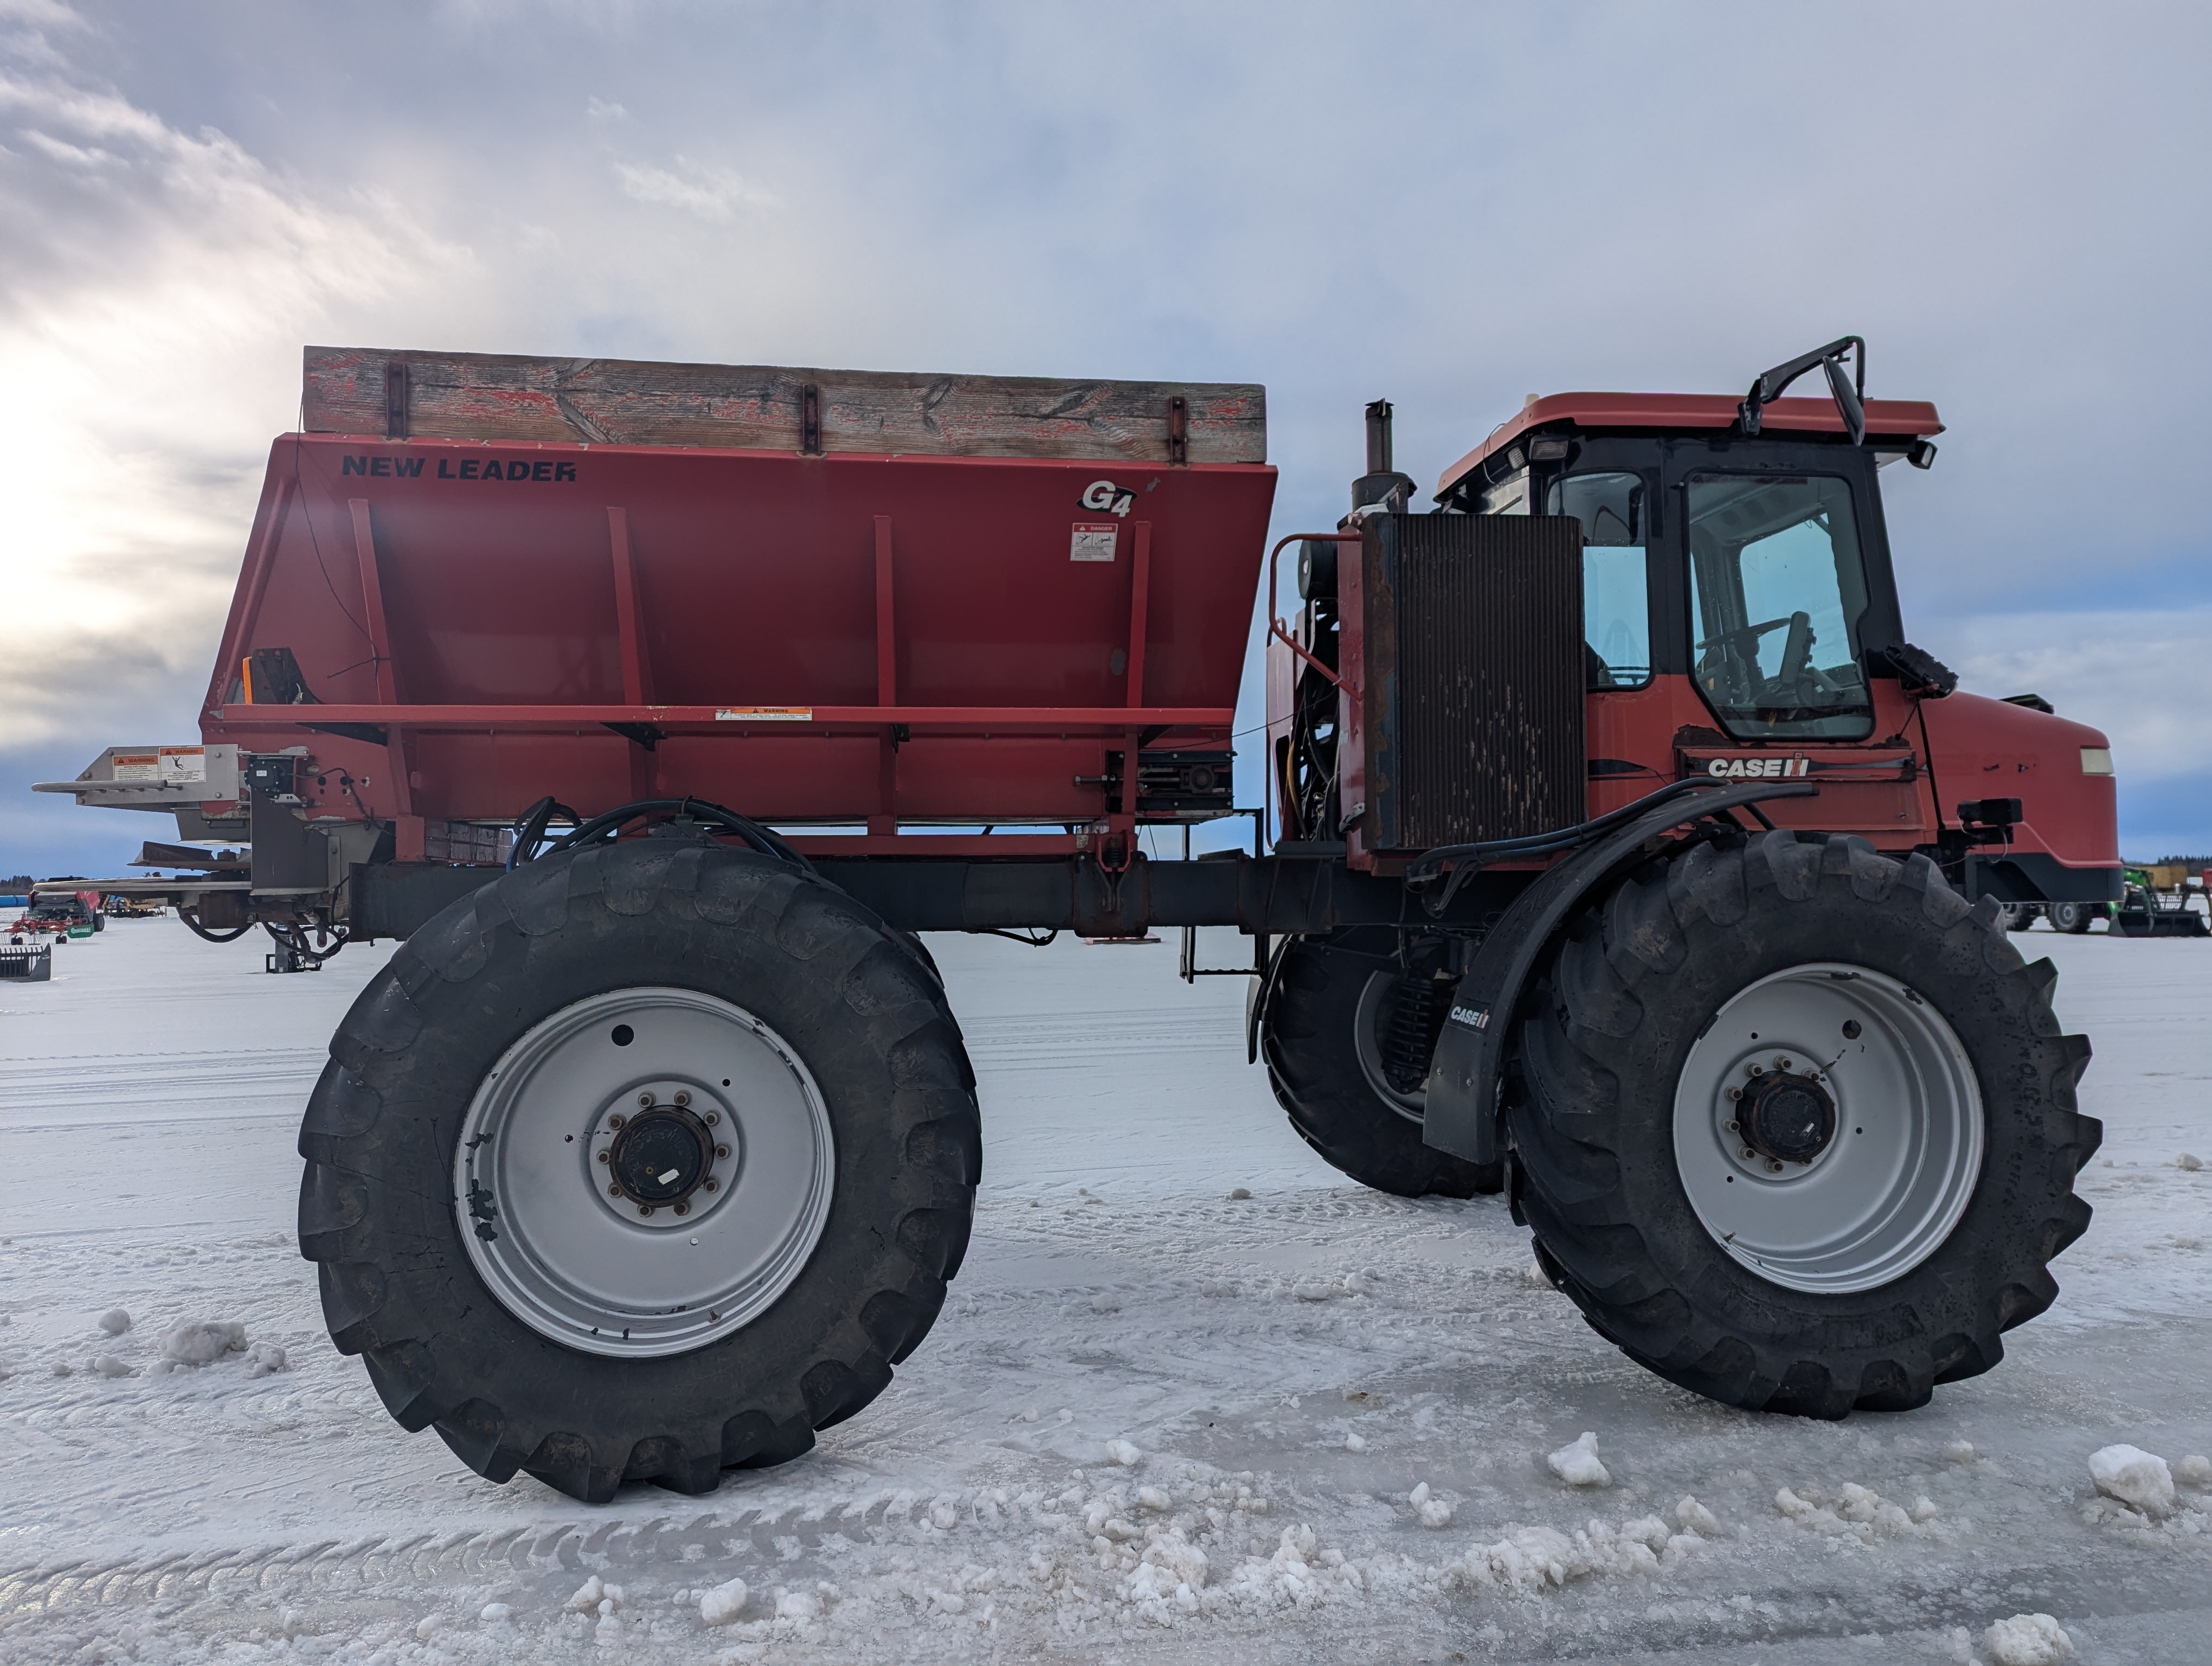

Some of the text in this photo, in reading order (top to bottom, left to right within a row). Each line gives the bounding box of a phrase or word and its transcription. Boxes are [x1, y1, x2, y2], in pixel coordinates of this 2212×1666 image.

[342, 455, 576, 482] NEW LEADER
[1082, 480, 1133, 518] G4
[1708, 758, 1782, 777] CASE
[1451, 1006, 1480, 1026] CASE
